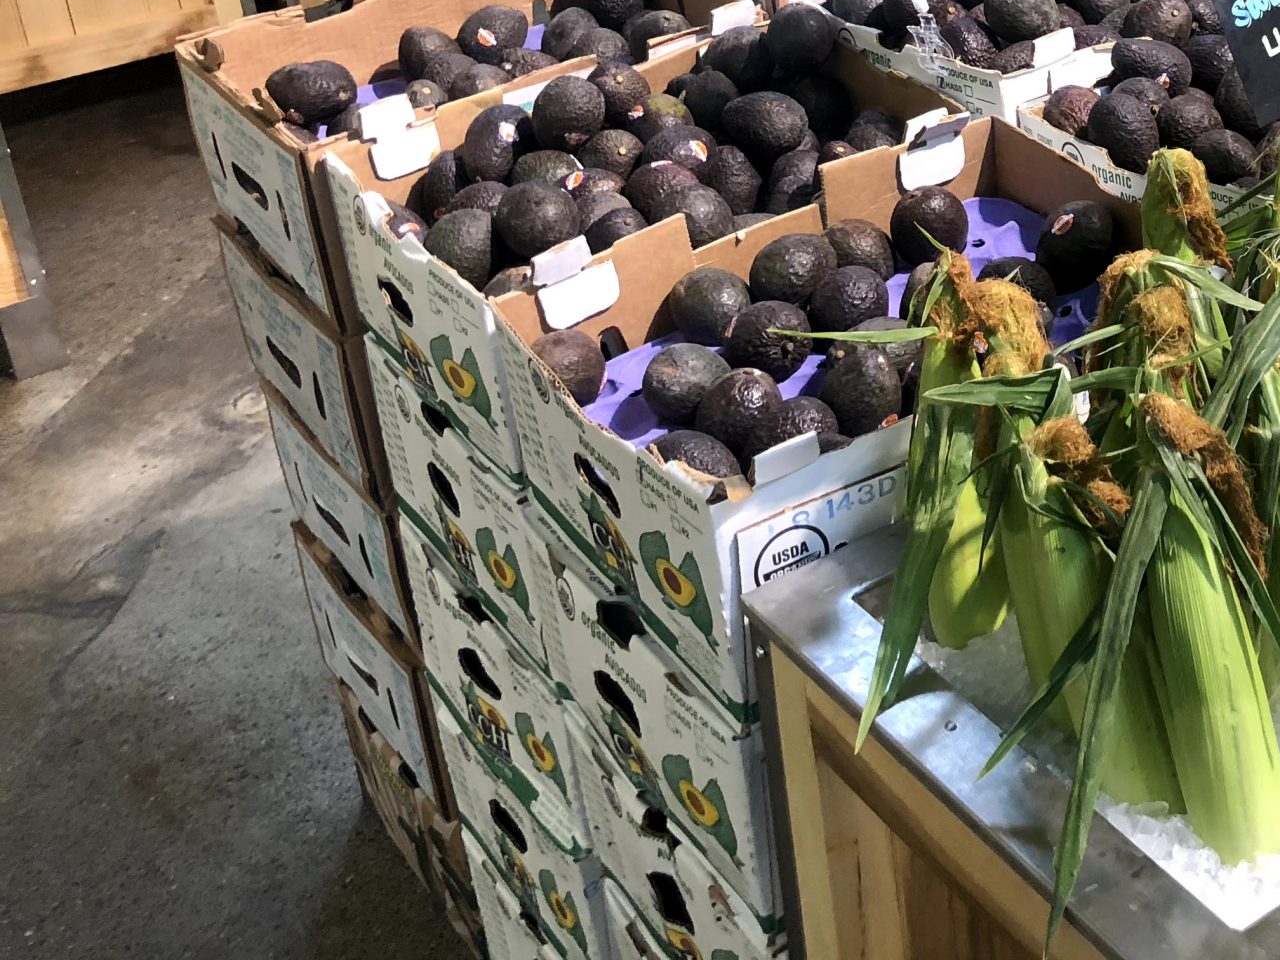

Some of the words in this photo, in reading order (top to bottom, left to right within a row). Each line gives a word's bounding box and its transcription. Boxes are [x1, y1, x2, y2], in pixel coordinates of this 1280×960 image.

[968, 74, 978, 84] OF
[979, 77, 994, 89] USA
[1091, 163, 1133, 190] organic
[383, 256, 415, 295] AVOCADOS
[428, 268, 455, 295] PRODUCE
[578, 433, 621, 481] AVOCADOS
[636, 455, 671, 491] PRODUCE
[683, 493, 700, 514] USA
[771, 540, 811, 567] USDA
[580, 610, 616, 655] organic
[604, 652, 647, 704] AVOCADOS
[666, 684, 698, 721] PRODUCE
[710, 726, 727, 745] USA
